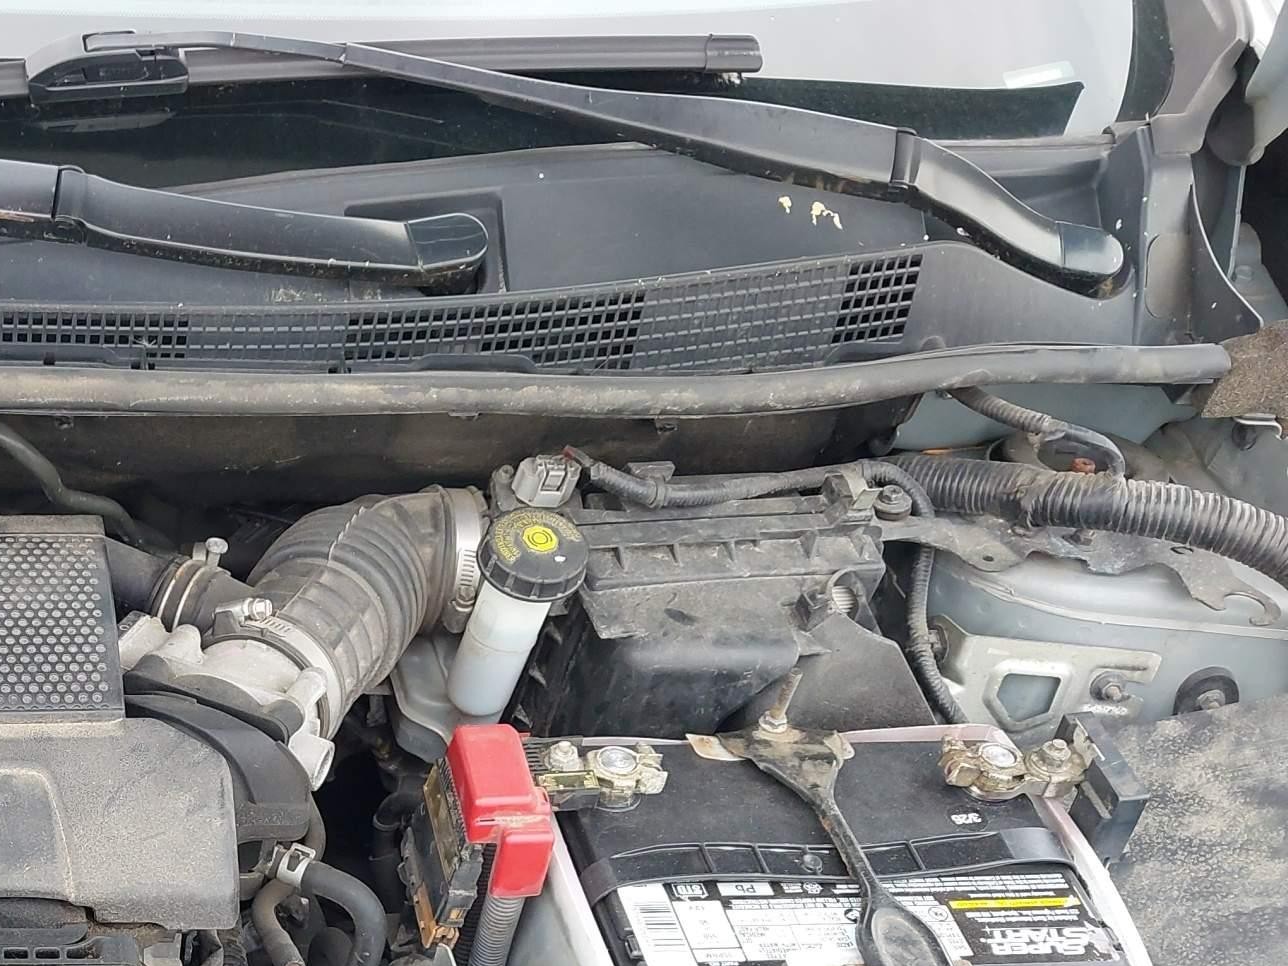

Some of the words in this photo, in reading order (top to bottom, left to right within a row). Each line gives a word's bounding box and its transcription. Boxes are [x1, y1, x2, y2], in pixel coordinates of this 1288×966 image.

[735, 884, 756, 894] Pb
[988, 928, 1089, 943] START
[990, 942, 1086, 956] SUPER
